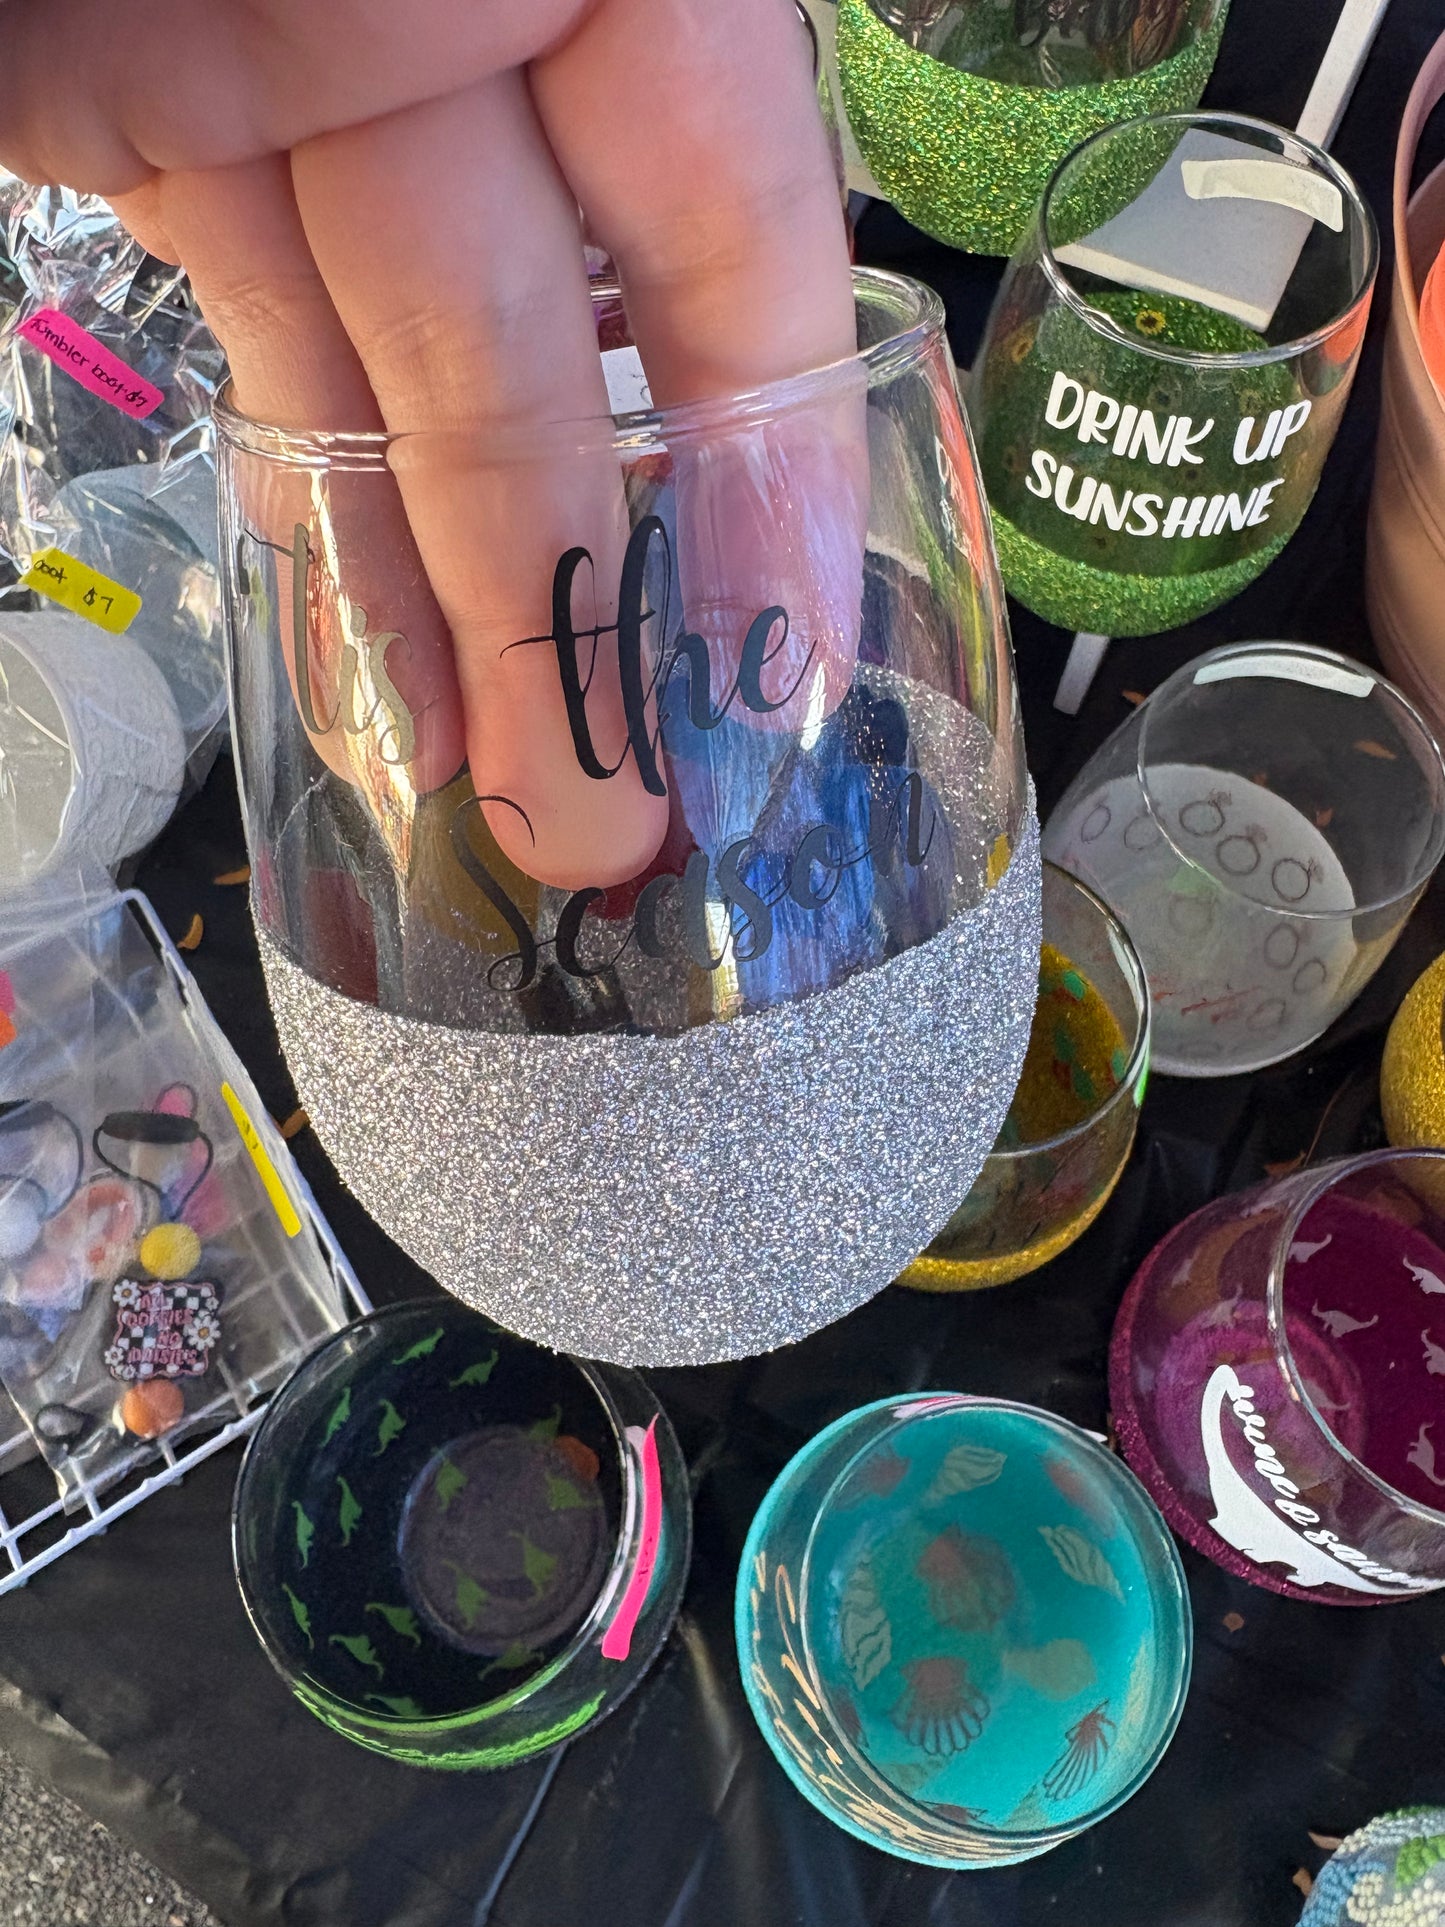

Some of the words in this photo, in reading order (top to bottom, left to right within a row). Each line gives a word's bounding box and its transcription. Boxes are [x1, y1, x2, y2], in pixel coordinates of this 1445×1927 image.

[1045, 370, 1215, 467] DRINK
[1232, 399, 1312, 466] UP
[1025, 449, 1286, 539] SUNSHINE
[499, 515, 816, 796] the
